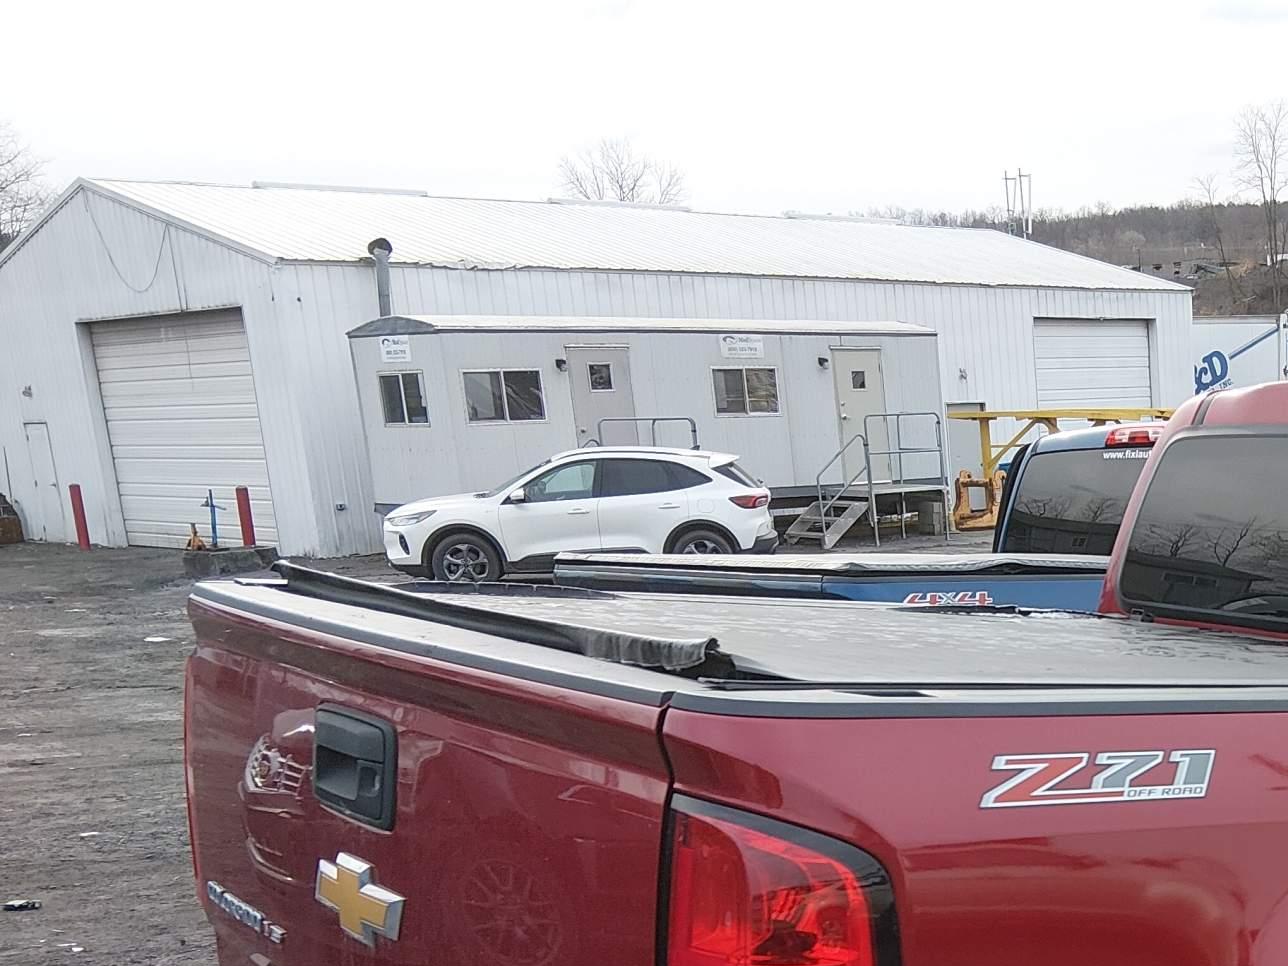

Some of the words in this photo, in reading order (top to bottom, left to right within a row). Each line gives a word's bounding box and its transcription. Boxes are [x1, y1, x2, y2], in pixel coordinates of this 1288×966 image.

[980, 749, 1216, 809] Z71
[1127, 788, 1156, 798] OFF
[1161, 786, 1204, 796] ROAD
